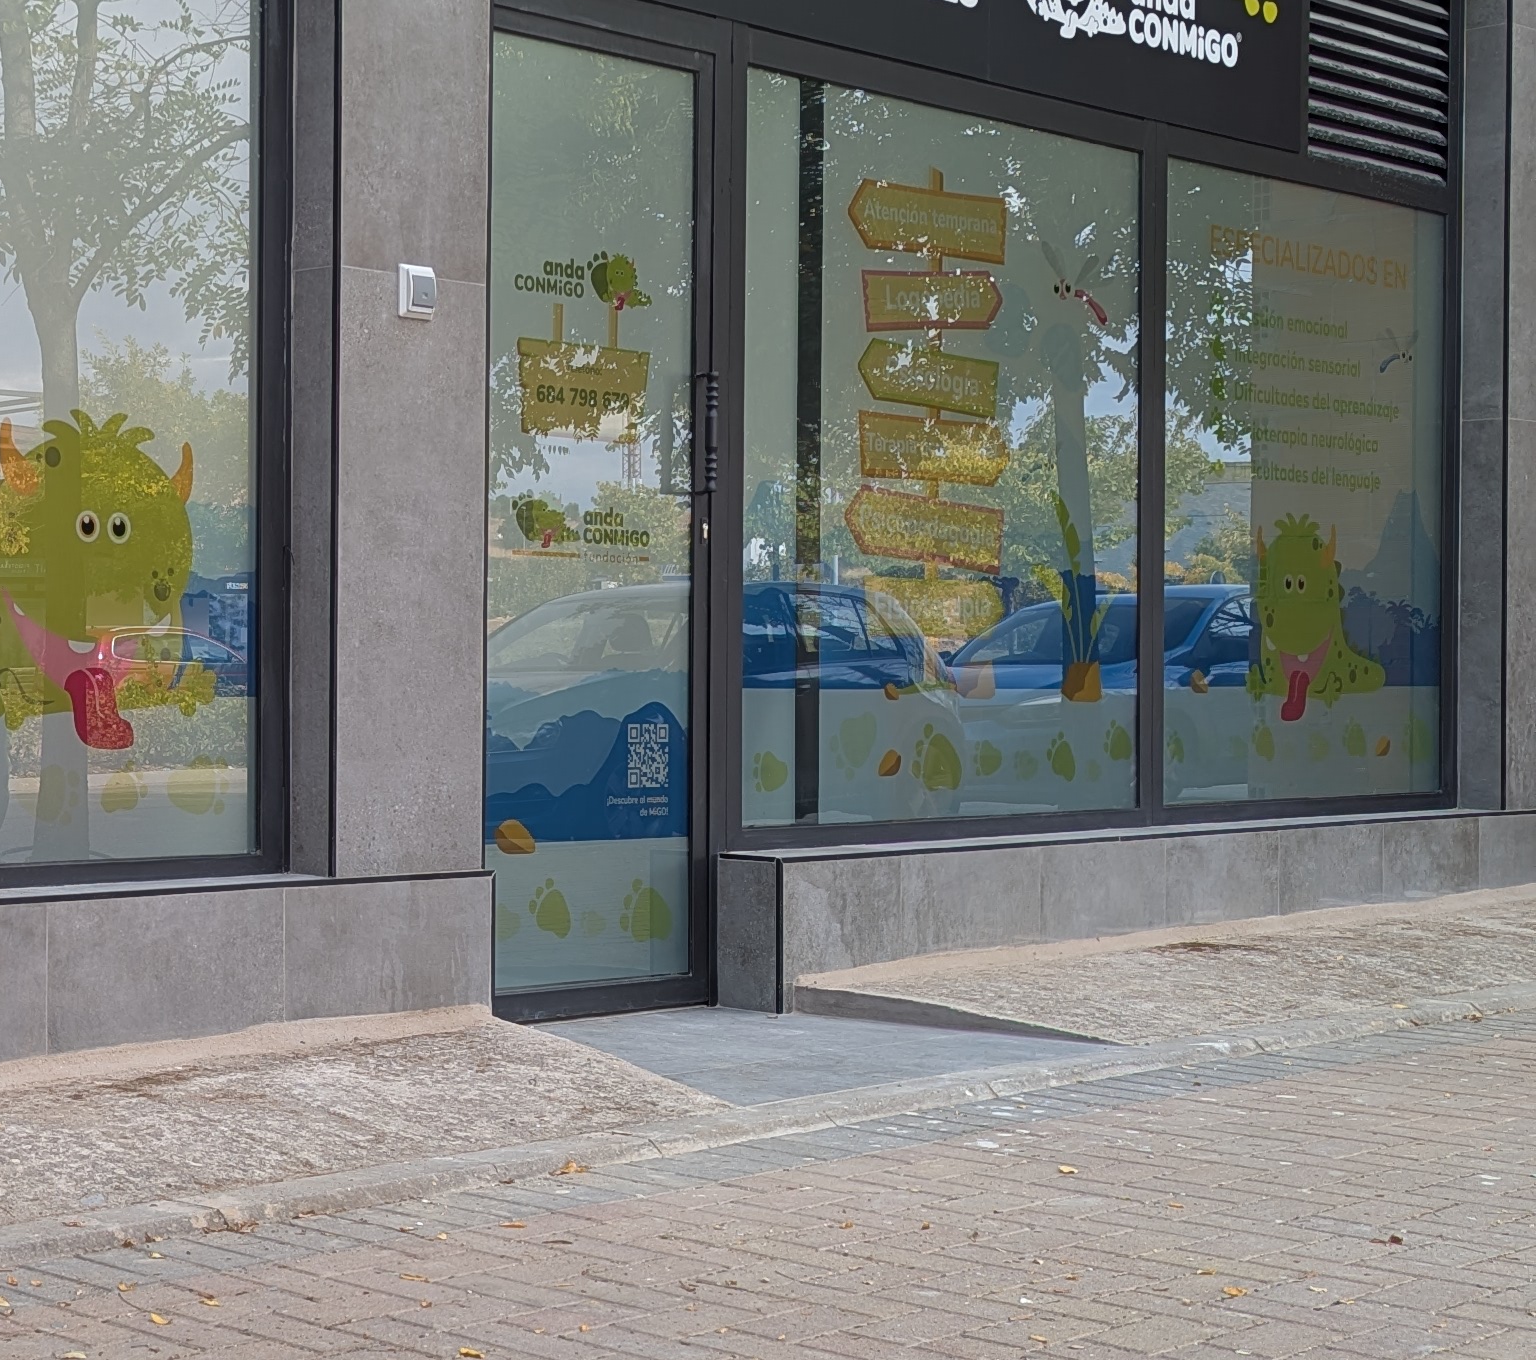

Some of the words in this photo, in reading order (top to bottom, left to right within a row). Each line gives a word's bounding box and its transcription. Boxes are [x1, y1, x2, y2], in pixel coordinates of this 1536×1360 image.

[864, 199, 928, 225] Atención
[932, 209, 997, 234] temprana
[543, 258, 585, 280] anda
[1383, 258, 1408, 289] EN
[1287, 317, 1348, 339] emocional
[1234, 346, 1306, 370] Integración
[1308, 358, 1361, 378] sensorial
[536, 384, 565, 405] 684
[570, 387, 598, 408] 798
[1234, 381, 1309, 409] Dificultades
[1312, 392, 1330, 411] del
[1333, 396, 1399, 423] aprendizaje
[1311, 466, 1329, 486] del
[1332, 468, 1381, 494] lenguaje
[583, 507, 624, 528] anda
[584, 551, 638, 564] fundación
